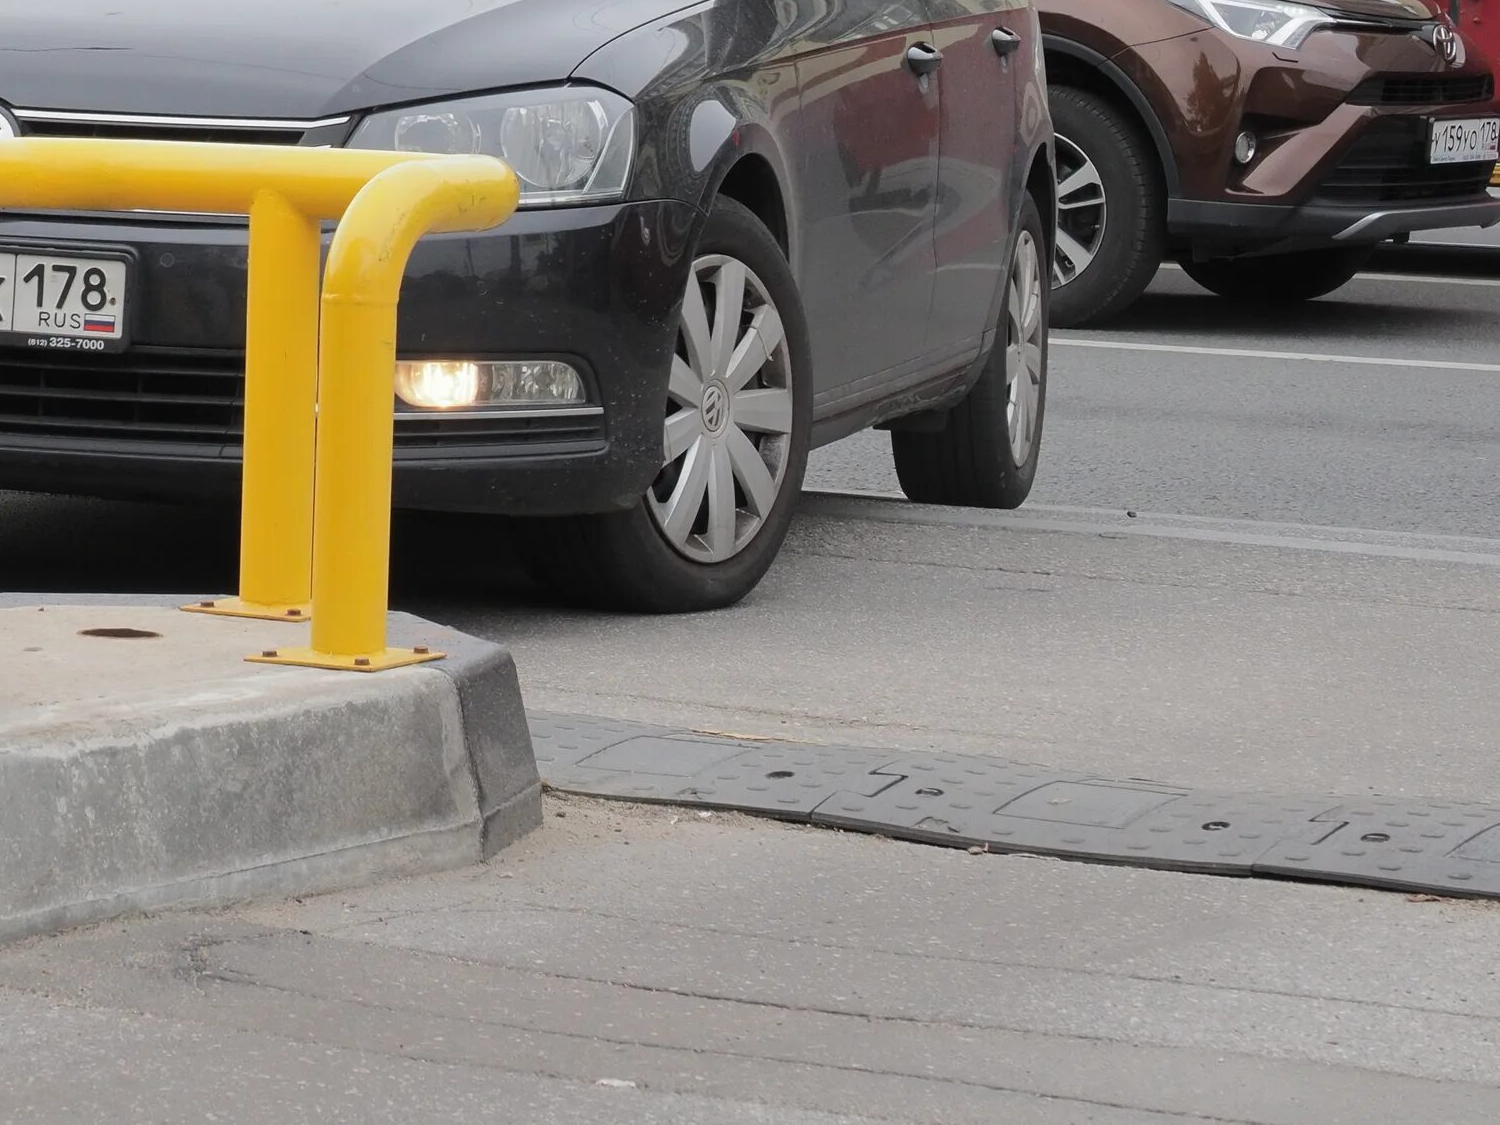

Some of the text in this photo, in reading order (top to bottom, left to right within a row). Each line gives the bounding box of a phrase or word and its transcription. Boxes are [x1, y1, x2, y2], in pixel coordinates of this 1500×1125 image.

[22, 263, 107, 312] 178
[38, 311, 81, 329] RUS
[49, 337, 105, 350] 325-7000
